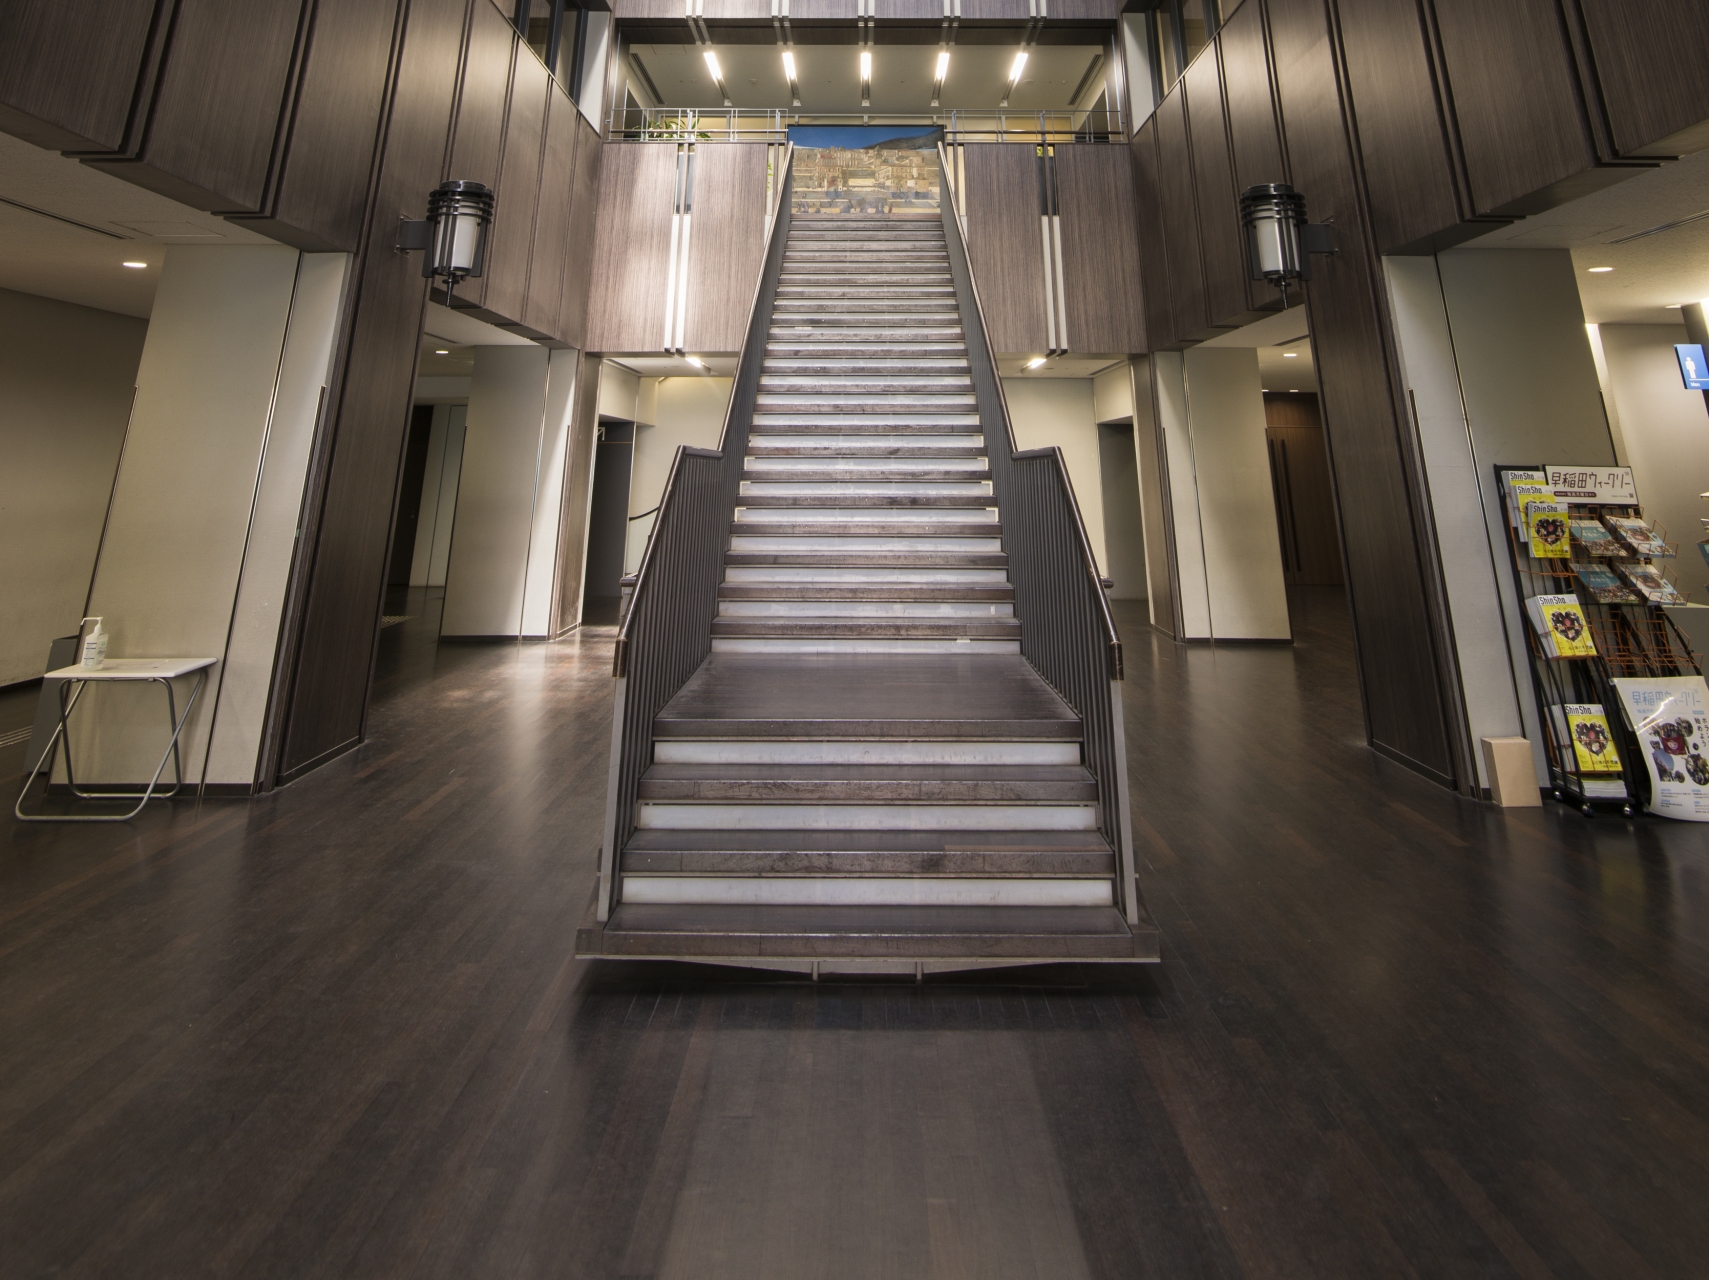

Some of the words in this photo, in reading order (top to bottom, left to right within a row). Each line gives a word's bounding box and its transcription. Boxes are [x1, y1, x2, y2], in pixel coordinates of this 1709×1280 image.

[1551, 471, 1631, 489] 早稲田ウィークリー
